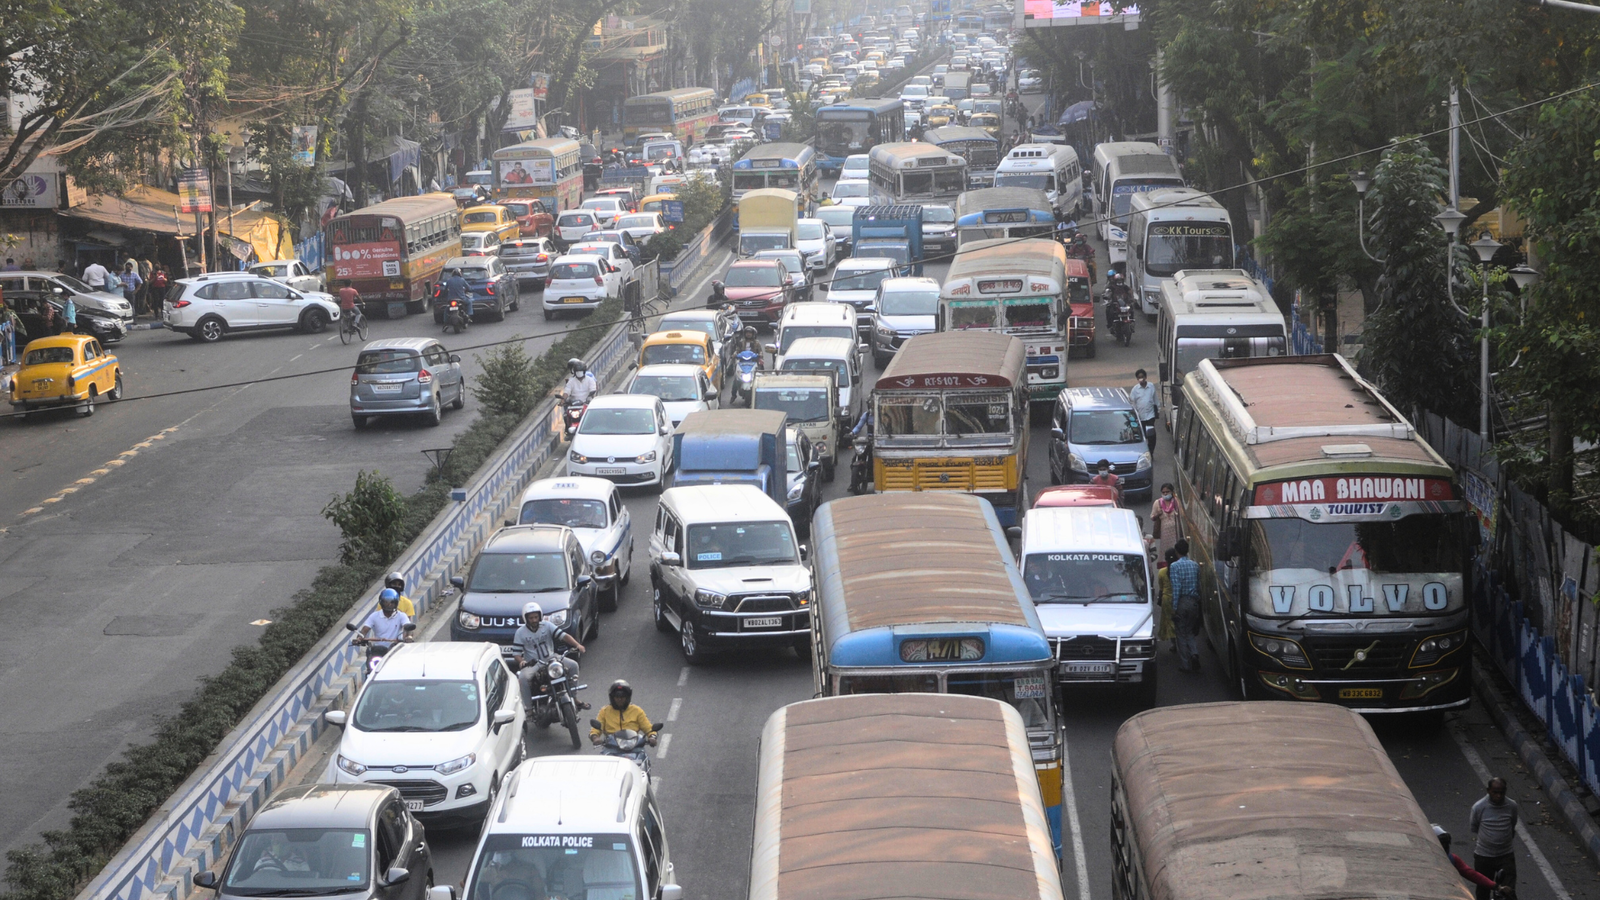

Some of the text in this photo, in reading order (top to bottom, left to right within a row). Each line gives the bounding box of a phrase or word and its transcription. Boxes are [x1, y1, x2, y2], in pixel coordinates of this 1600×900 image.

[1183, 226, 1211, 235] Tours
[1282, 478, 1425, 503] MAA BHAWANI
[1327, 503, 1384, 515] TOURIST
[1048, 554, 1125, 562] KOLKATA POLICE
[1268, 581, 1448, 613] VOLVO
[521, 836, 593, 848] KOLKATA POLICE
